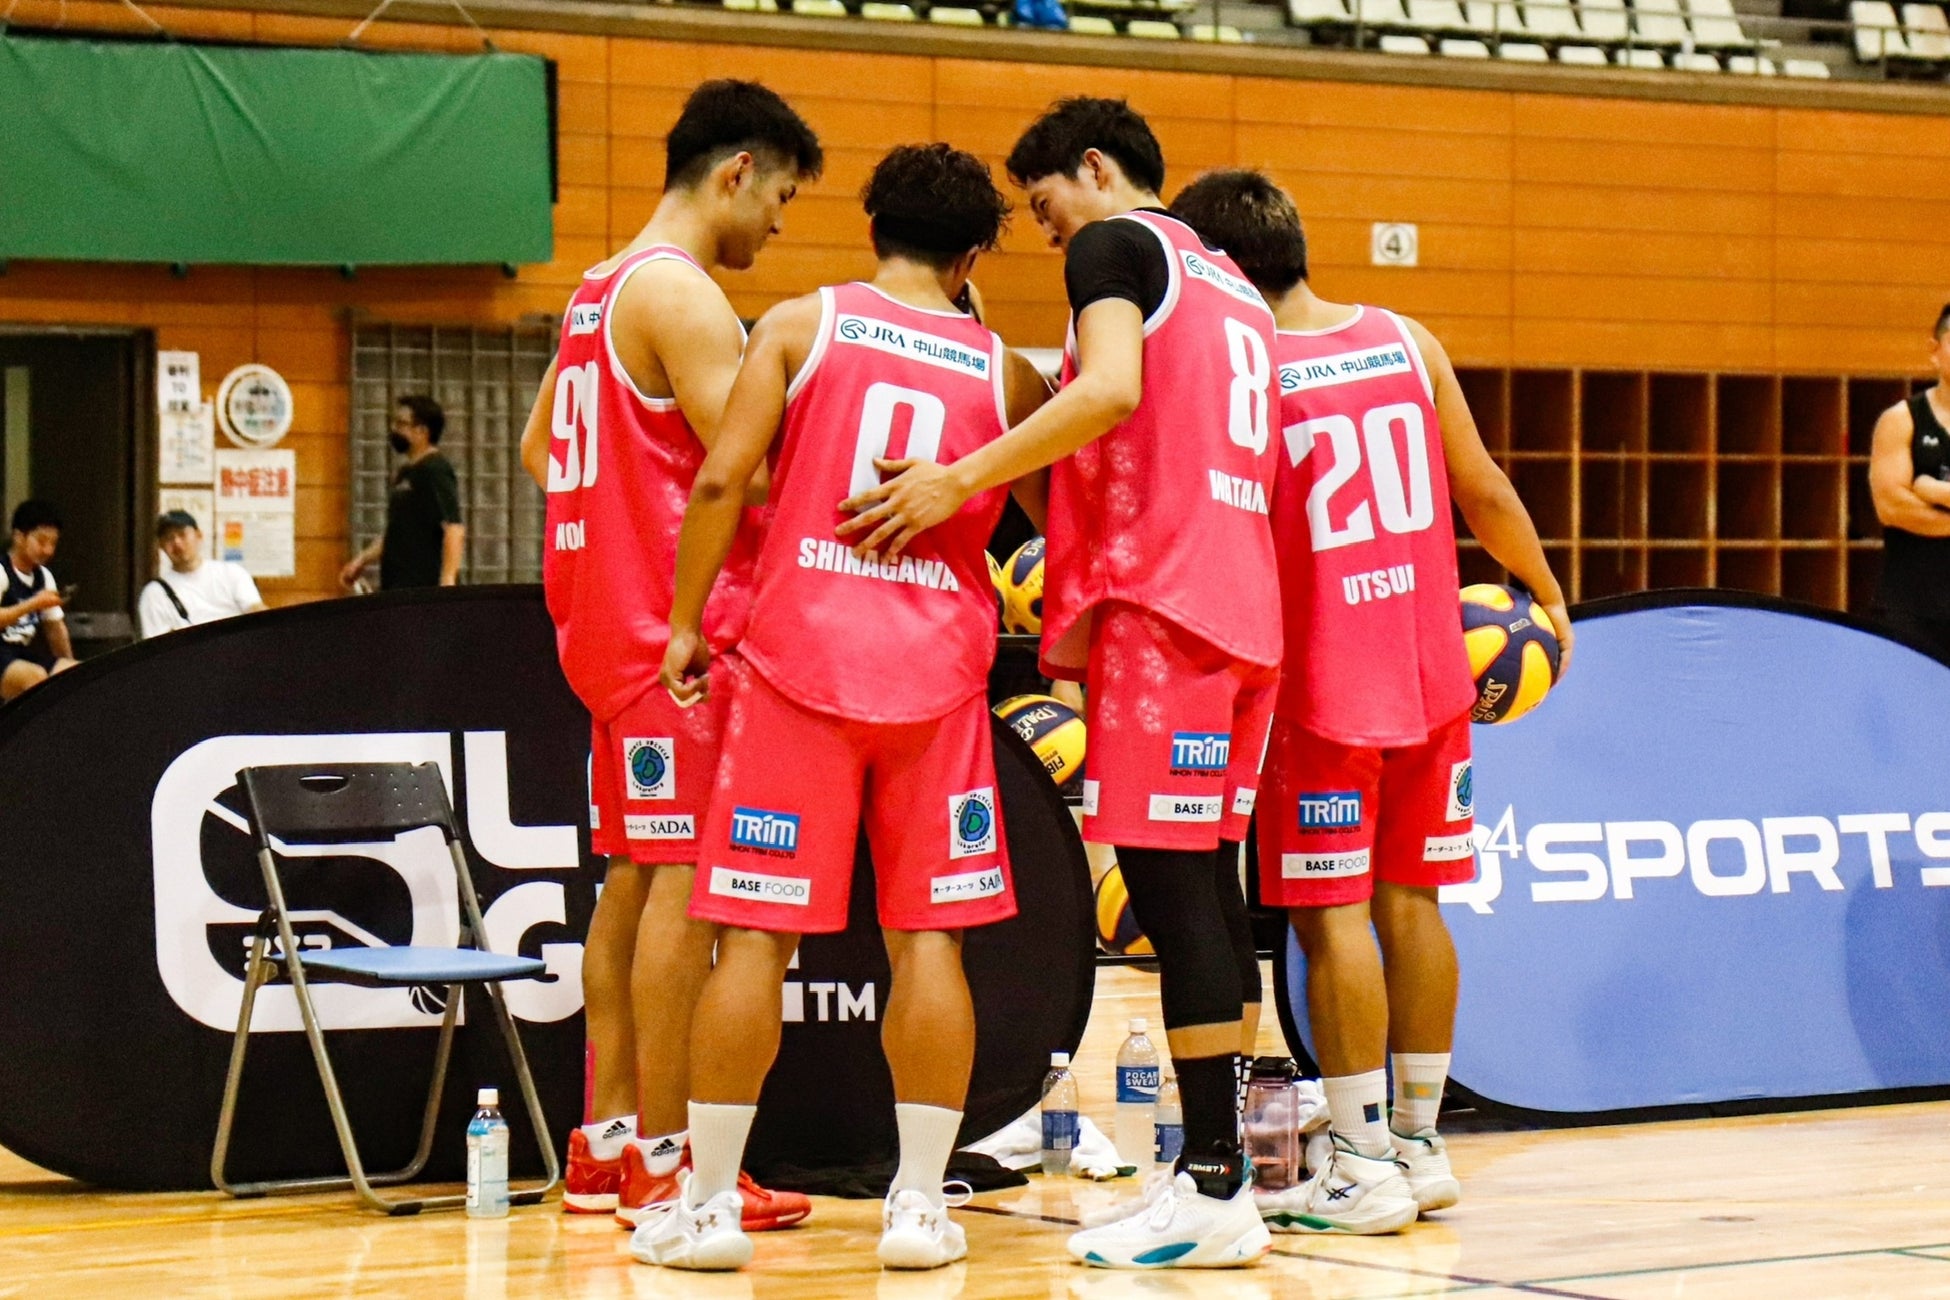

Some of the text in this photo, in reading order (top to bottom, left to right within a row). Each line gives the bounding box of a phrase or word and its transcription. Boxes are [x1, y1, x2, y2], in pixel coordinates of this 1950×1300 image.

[1384, 232, 1403, 256] 4
[869, 326, 986, 372] JRA 中山競馬場
[1304, 350, 1406, 381] JRA 中山競馬場
[1223, 316, 1272, 457] 8
[847, 381, 946, 515] 0
[1283, 401, 1435, 553] 20
[797, 536, 960, 593] SHINAGAWA
[1341, 563, 1416, 606] UTSUI
[1174, 802, 1220, 815] BASE FO
[650, 820, 692, 834] SADA
[1305, 855, 1368, 871] BASE FOOD
[731, 878, 805, 896] BASE FOOD
[602, 1127, 632, 1139] adidas
[651, 1145, 681, 1157] adidas
